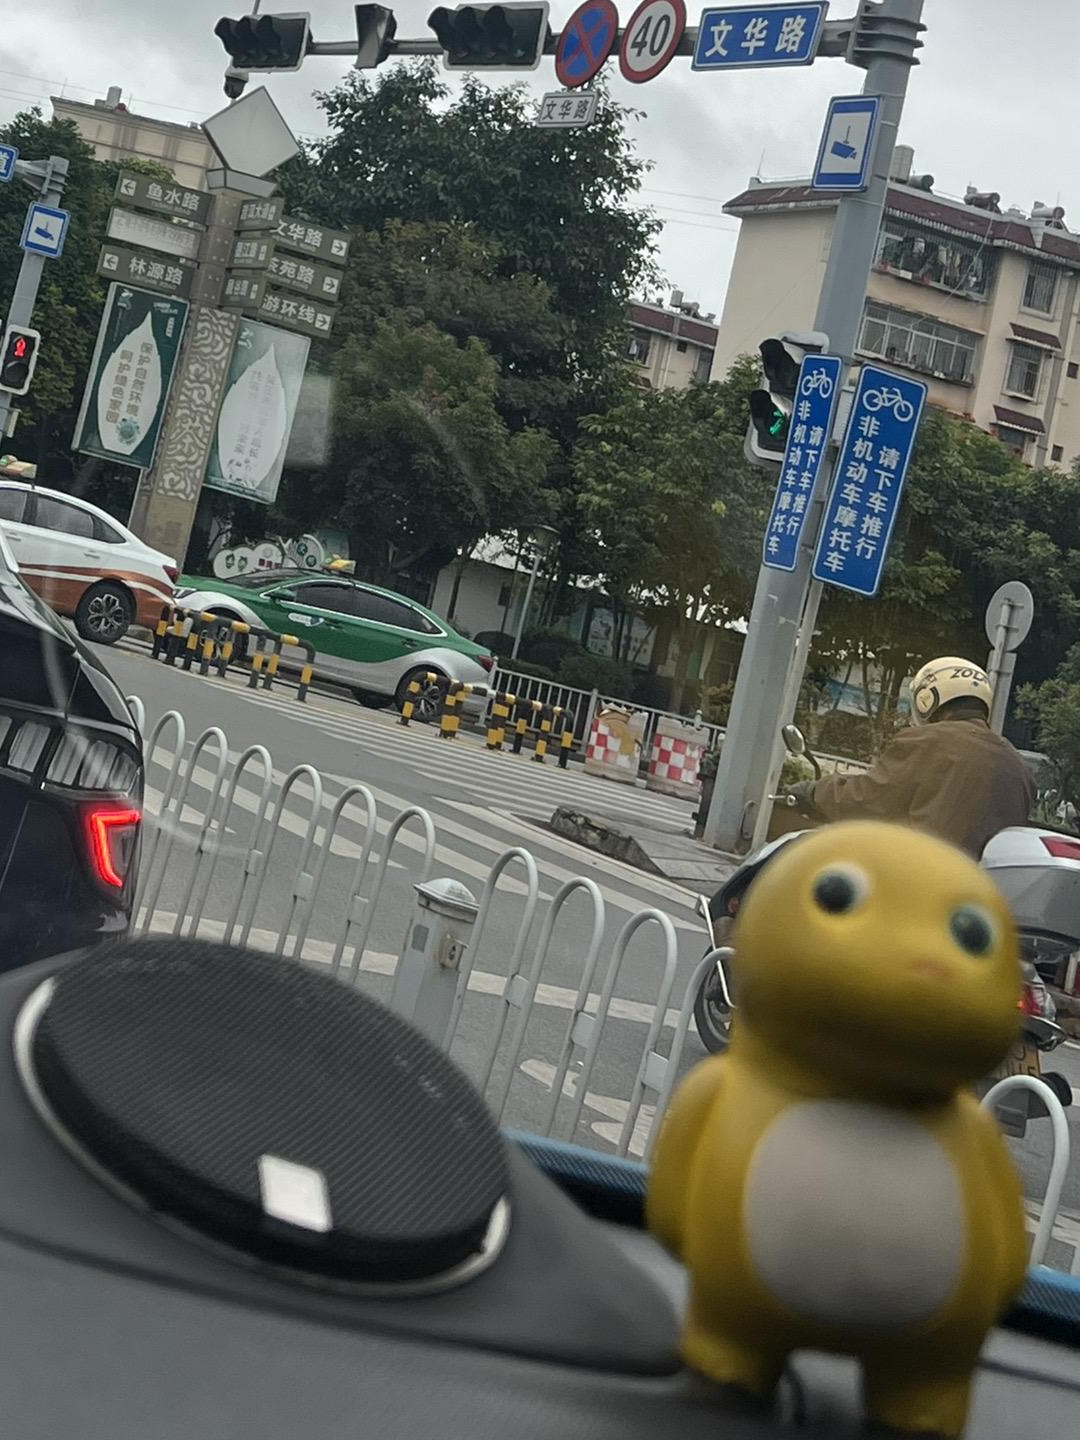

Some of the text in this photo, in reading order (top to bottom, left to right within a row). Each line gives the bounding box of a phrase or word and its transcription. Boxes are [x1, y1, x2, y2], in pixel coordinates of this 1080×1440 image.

[630, 13, 671, 58] 40
[705, 15, 806, 57] 文华路
[542, 99, 589, 121] 文华路
[146, 182, 200, 212] 鱼水路
[129, 256, 184, 286] 林源路
[767, 400, 812, 556] 非机动车摩托车
[786, 425, 824, 536] 请下车推行
[824, 415, 880, 573] 非机动车摩托车
[855, 446, 901, 559] 请下车推行
